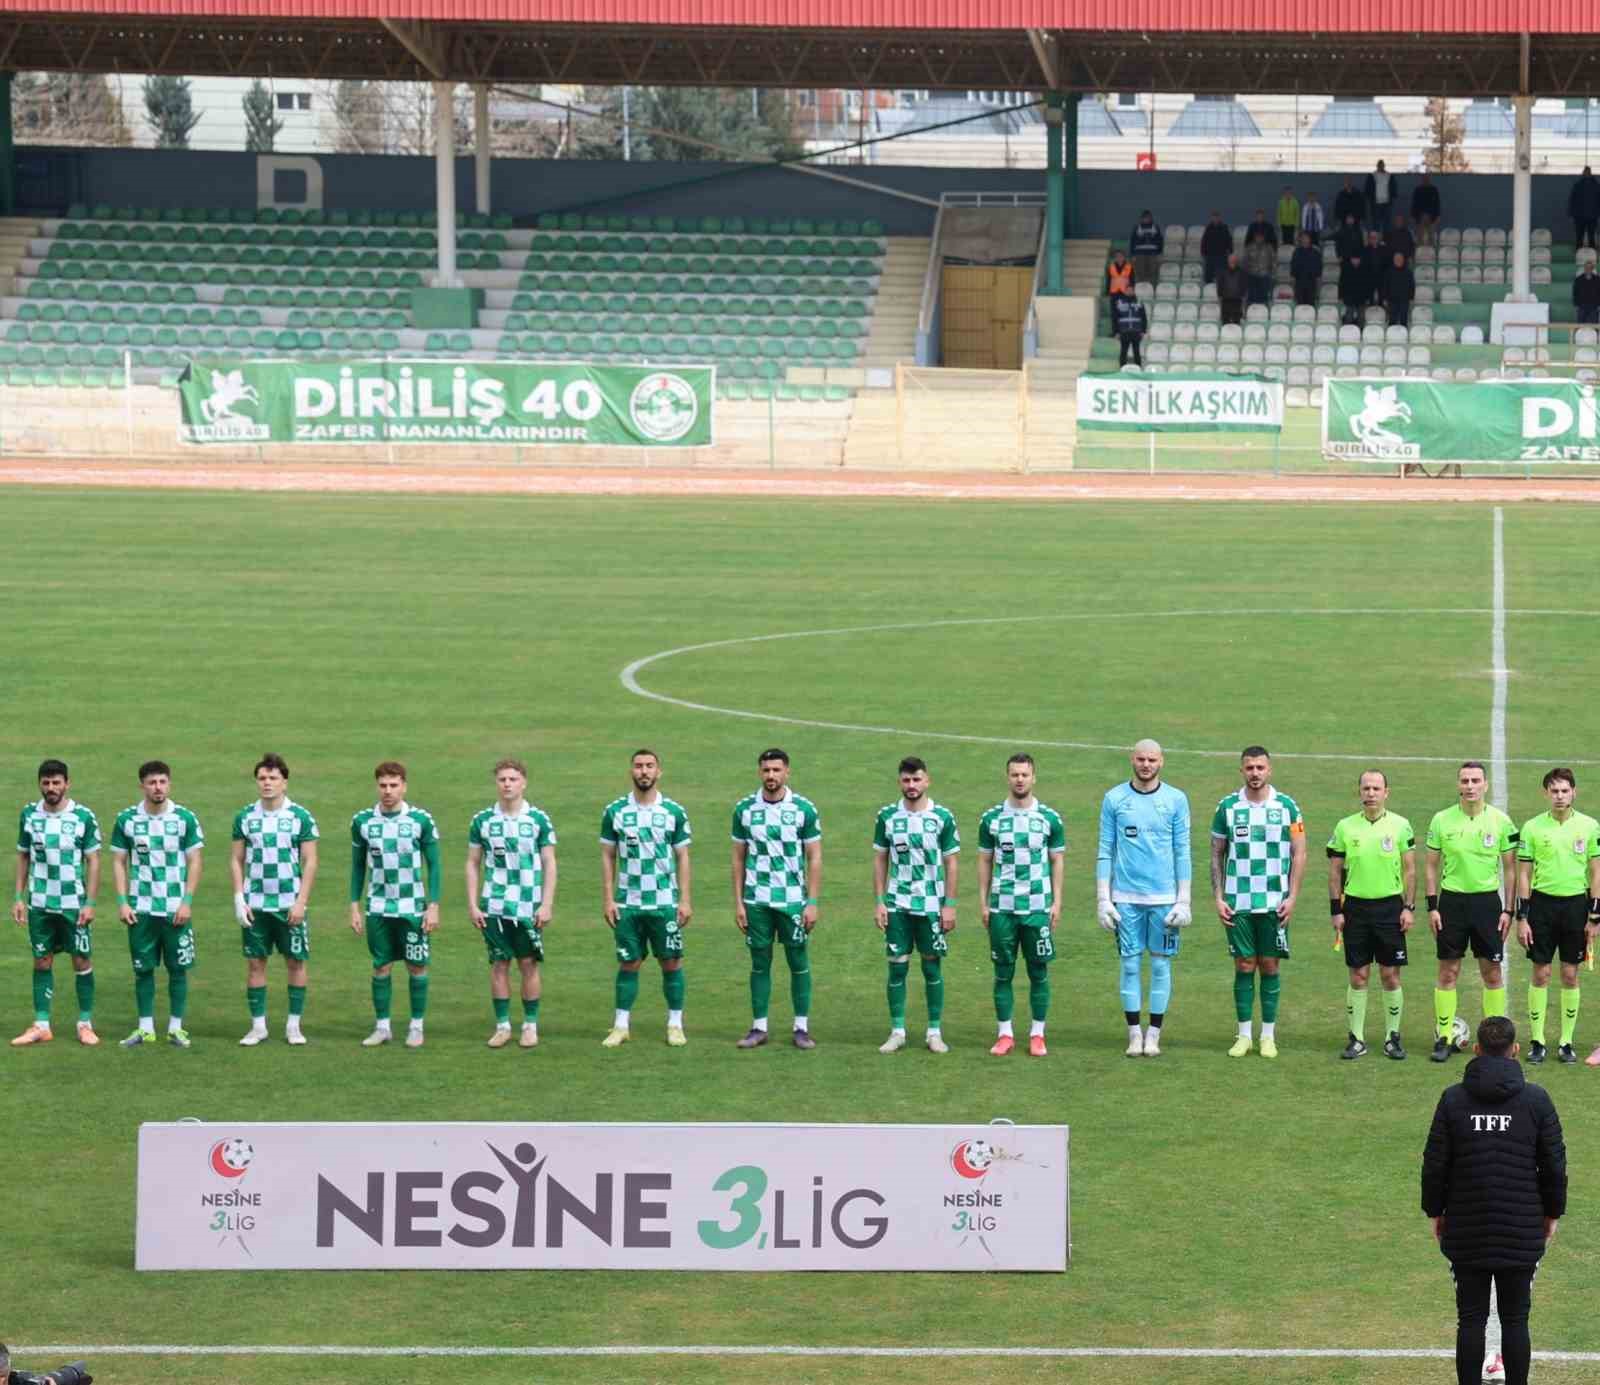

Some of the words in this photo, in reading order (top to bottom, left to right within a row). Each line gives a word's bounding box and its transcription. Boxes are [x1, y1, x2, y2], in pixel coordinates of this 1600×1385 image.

[294, 366, 506, 425] DİRİLİŞ
[522, 379, 602, 421] 40
[1092, 388, 1139, 414] SEN
[1147, 384, 1184, 415] İLK
[1189, 390, 1269, 420] AŞKIM
[295, 423, 376, 438] ZAFER
[291, 936, 302, 953] 8
[1471, 1114, 1512, 1131] TFF
